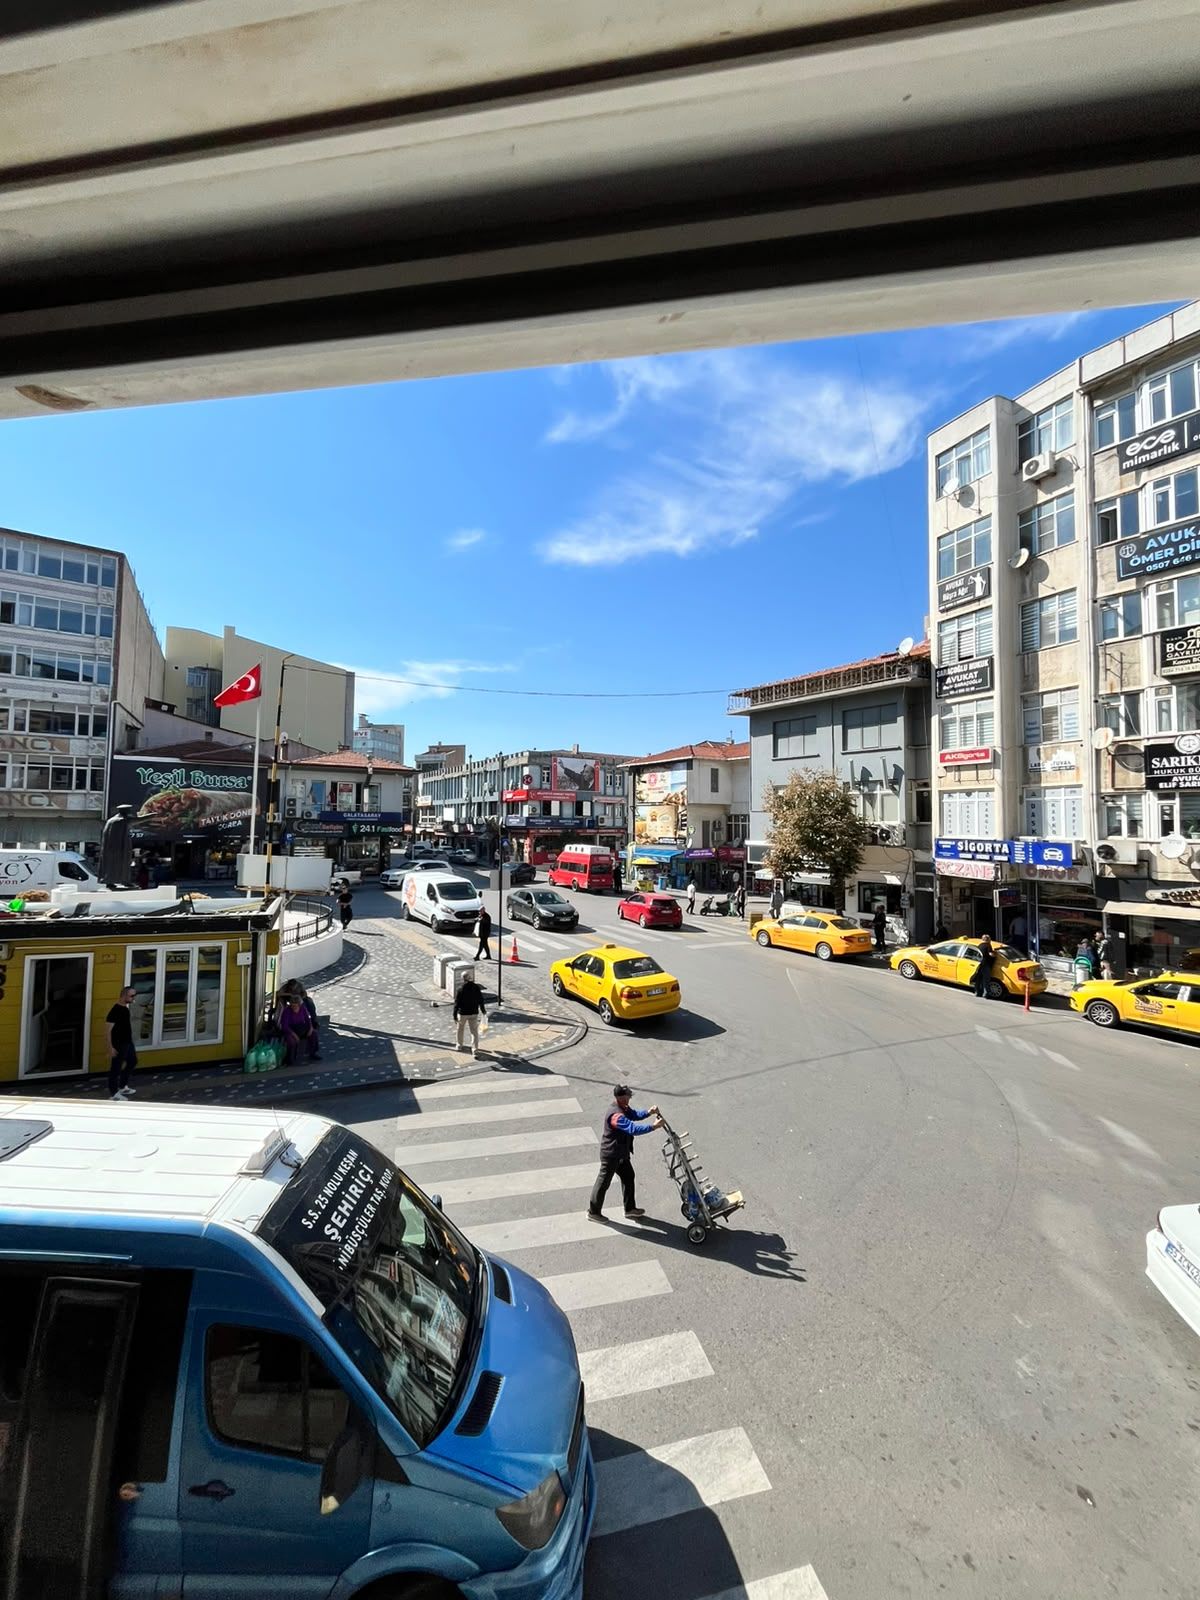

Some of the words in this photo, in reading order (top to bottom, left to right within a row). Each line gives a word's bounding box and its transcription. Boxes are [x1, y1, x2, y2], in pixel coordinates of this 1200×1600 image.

[1126, 429, 1176, 456] ece
[1122, 442, 1180, 469] mimarlık
[1145, 526, 1200, 550] AVUK
[1129, 548, 1175, 567] ÖMER
[1146, 560, 1170, 572] 0507
[945, 670, 979, 685] AVUKAT
[1151, 755, 1200, 769] SARIK
[1153, 767, 1186, 775] HUKUK
[136, 768, 187, 788] Yeşil
[190, 770, 249, 788] Bursa
[1171, 775, 1200, 783] AVUK
[1030, 803, 1038, 835] DASK
[957, 839, 1010, 854] SİGORTA
[301, 1209, 322, 1229] S.S.
[314, 1194, 329, 1210] 25
[322, 1171, 343, 1197] NOLU
[338, 1149, 358, 1176] KEŞAN
[324, 1161, 374, 1242] ŞEHİRİÇİ
